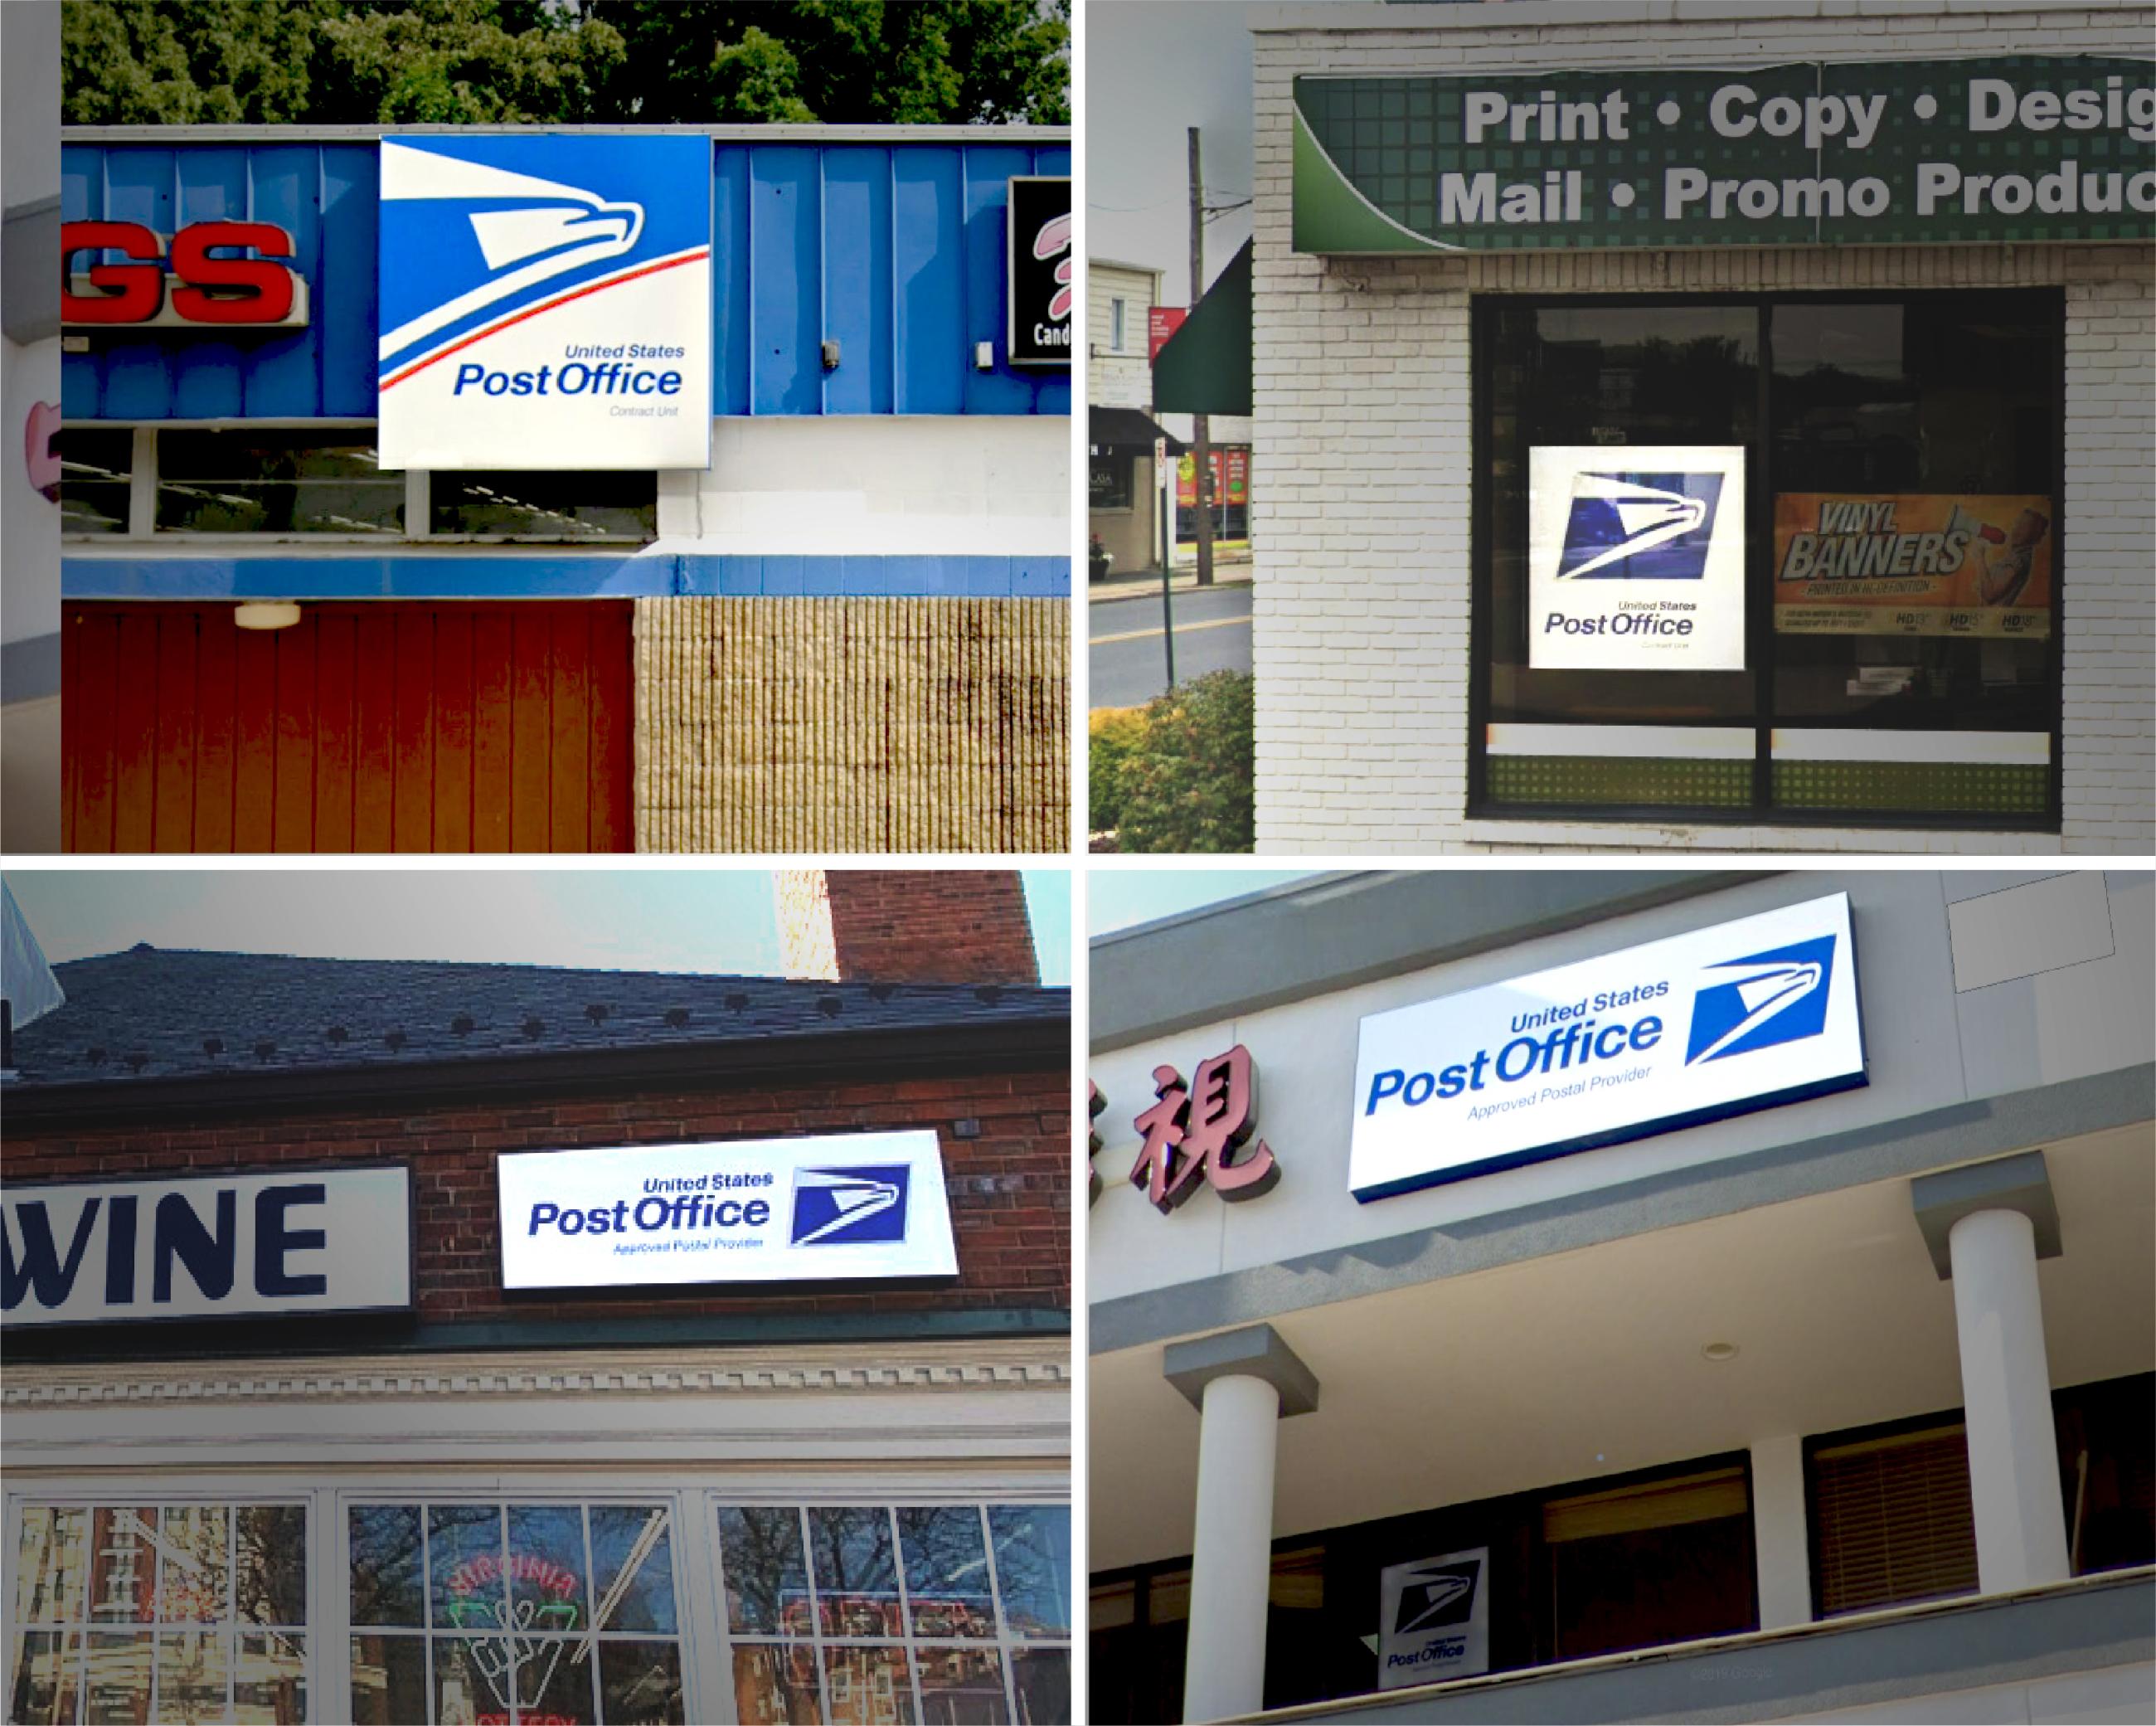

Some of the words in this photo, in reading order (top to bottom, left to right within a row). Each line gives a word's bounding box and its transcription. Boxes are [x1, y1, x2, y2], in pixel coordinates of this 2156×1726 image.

[1464, 88, 1629, 143] Print
[1710, 84, 1888, 149] Copy
[1969, 75, 2156, 142] Desig
[1440, 170, 1582, 225] Mail
[1664, 168, 1891, 220] Promo
[1917, 159, 2156, 216] Produc
[61, 221, 294, 323] GS
[566, 344, 624, 358] United
[629, 344, 685, 358] States
[454, 363, 551, 396] Post
[556, 362, 682, 396] Office
[609, 406, 655, 417] Contract
[658, 406, 679, 417] Unit
[1819, 502, 1898, 536] VINYL
[1780, 530, 1970, 581] BANNERS
[1544, 612, 1607, 635] Post
[1610, 612, 1694, 635] Office
[1619, 600, 1658, 611] United
[1660, 600, 1697, 611] States
[1511, 997, 1588, 1033] United
[1593, 980, 1670, 1012] States
[1364, 1048, 1491, 1117] Post
[1495, 1014, 1663, 1082] Office
[1467, 1092, 1537, 1121] Approved
[1541, 1079, 1586, 1103] Postal
[1590, 1065, 1653, 1092] Provider
[1089, 1043, 1280, 1215] 視
[643, 1174, 708, 1194] United
[712, 1172, 774, 1191] States
[527, 1199, 629, 1237] Post
[634, 1194, 770, 1231] Office
[0, 1183, 328, 1310] WINE
[1387, 1651, 1420, 1670] Post
[1421, 1644, 1465, 1661] Office
